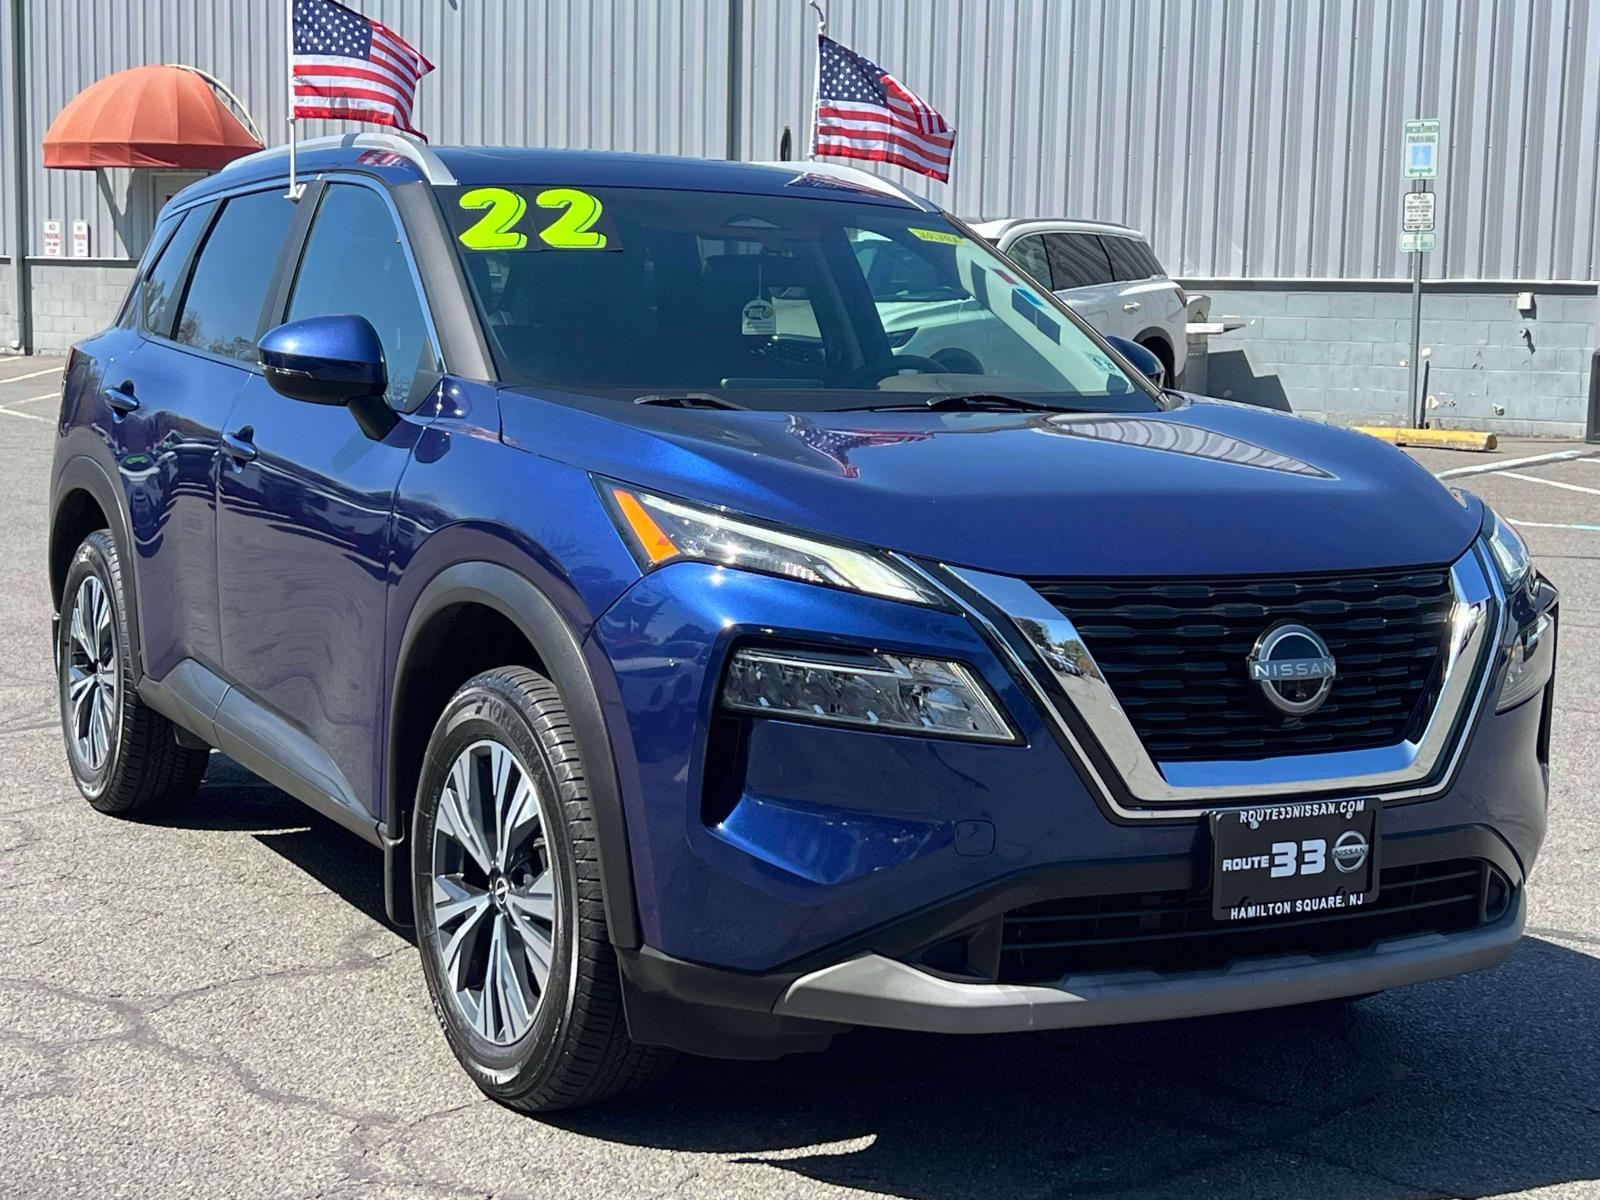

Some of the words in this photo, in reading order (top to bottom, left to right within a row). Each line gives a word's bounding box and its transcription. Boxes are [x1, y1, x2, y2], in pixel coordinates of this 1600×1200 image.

[458, 187, 607, 250] 22
[1254, 661, 1333, 677] NISSAN
[1239, 800, 1364, 823] ROUTE33NISSAN.COM
[1222, 855, 1270, 872] ROUTE
[1270, 839, 1326, 878] 33
[1335, 848, 1364, 857] NISSAN
[1230, 903, 1291, 920] HAMILTON
[1349, 893, 1364, 906] NJ
